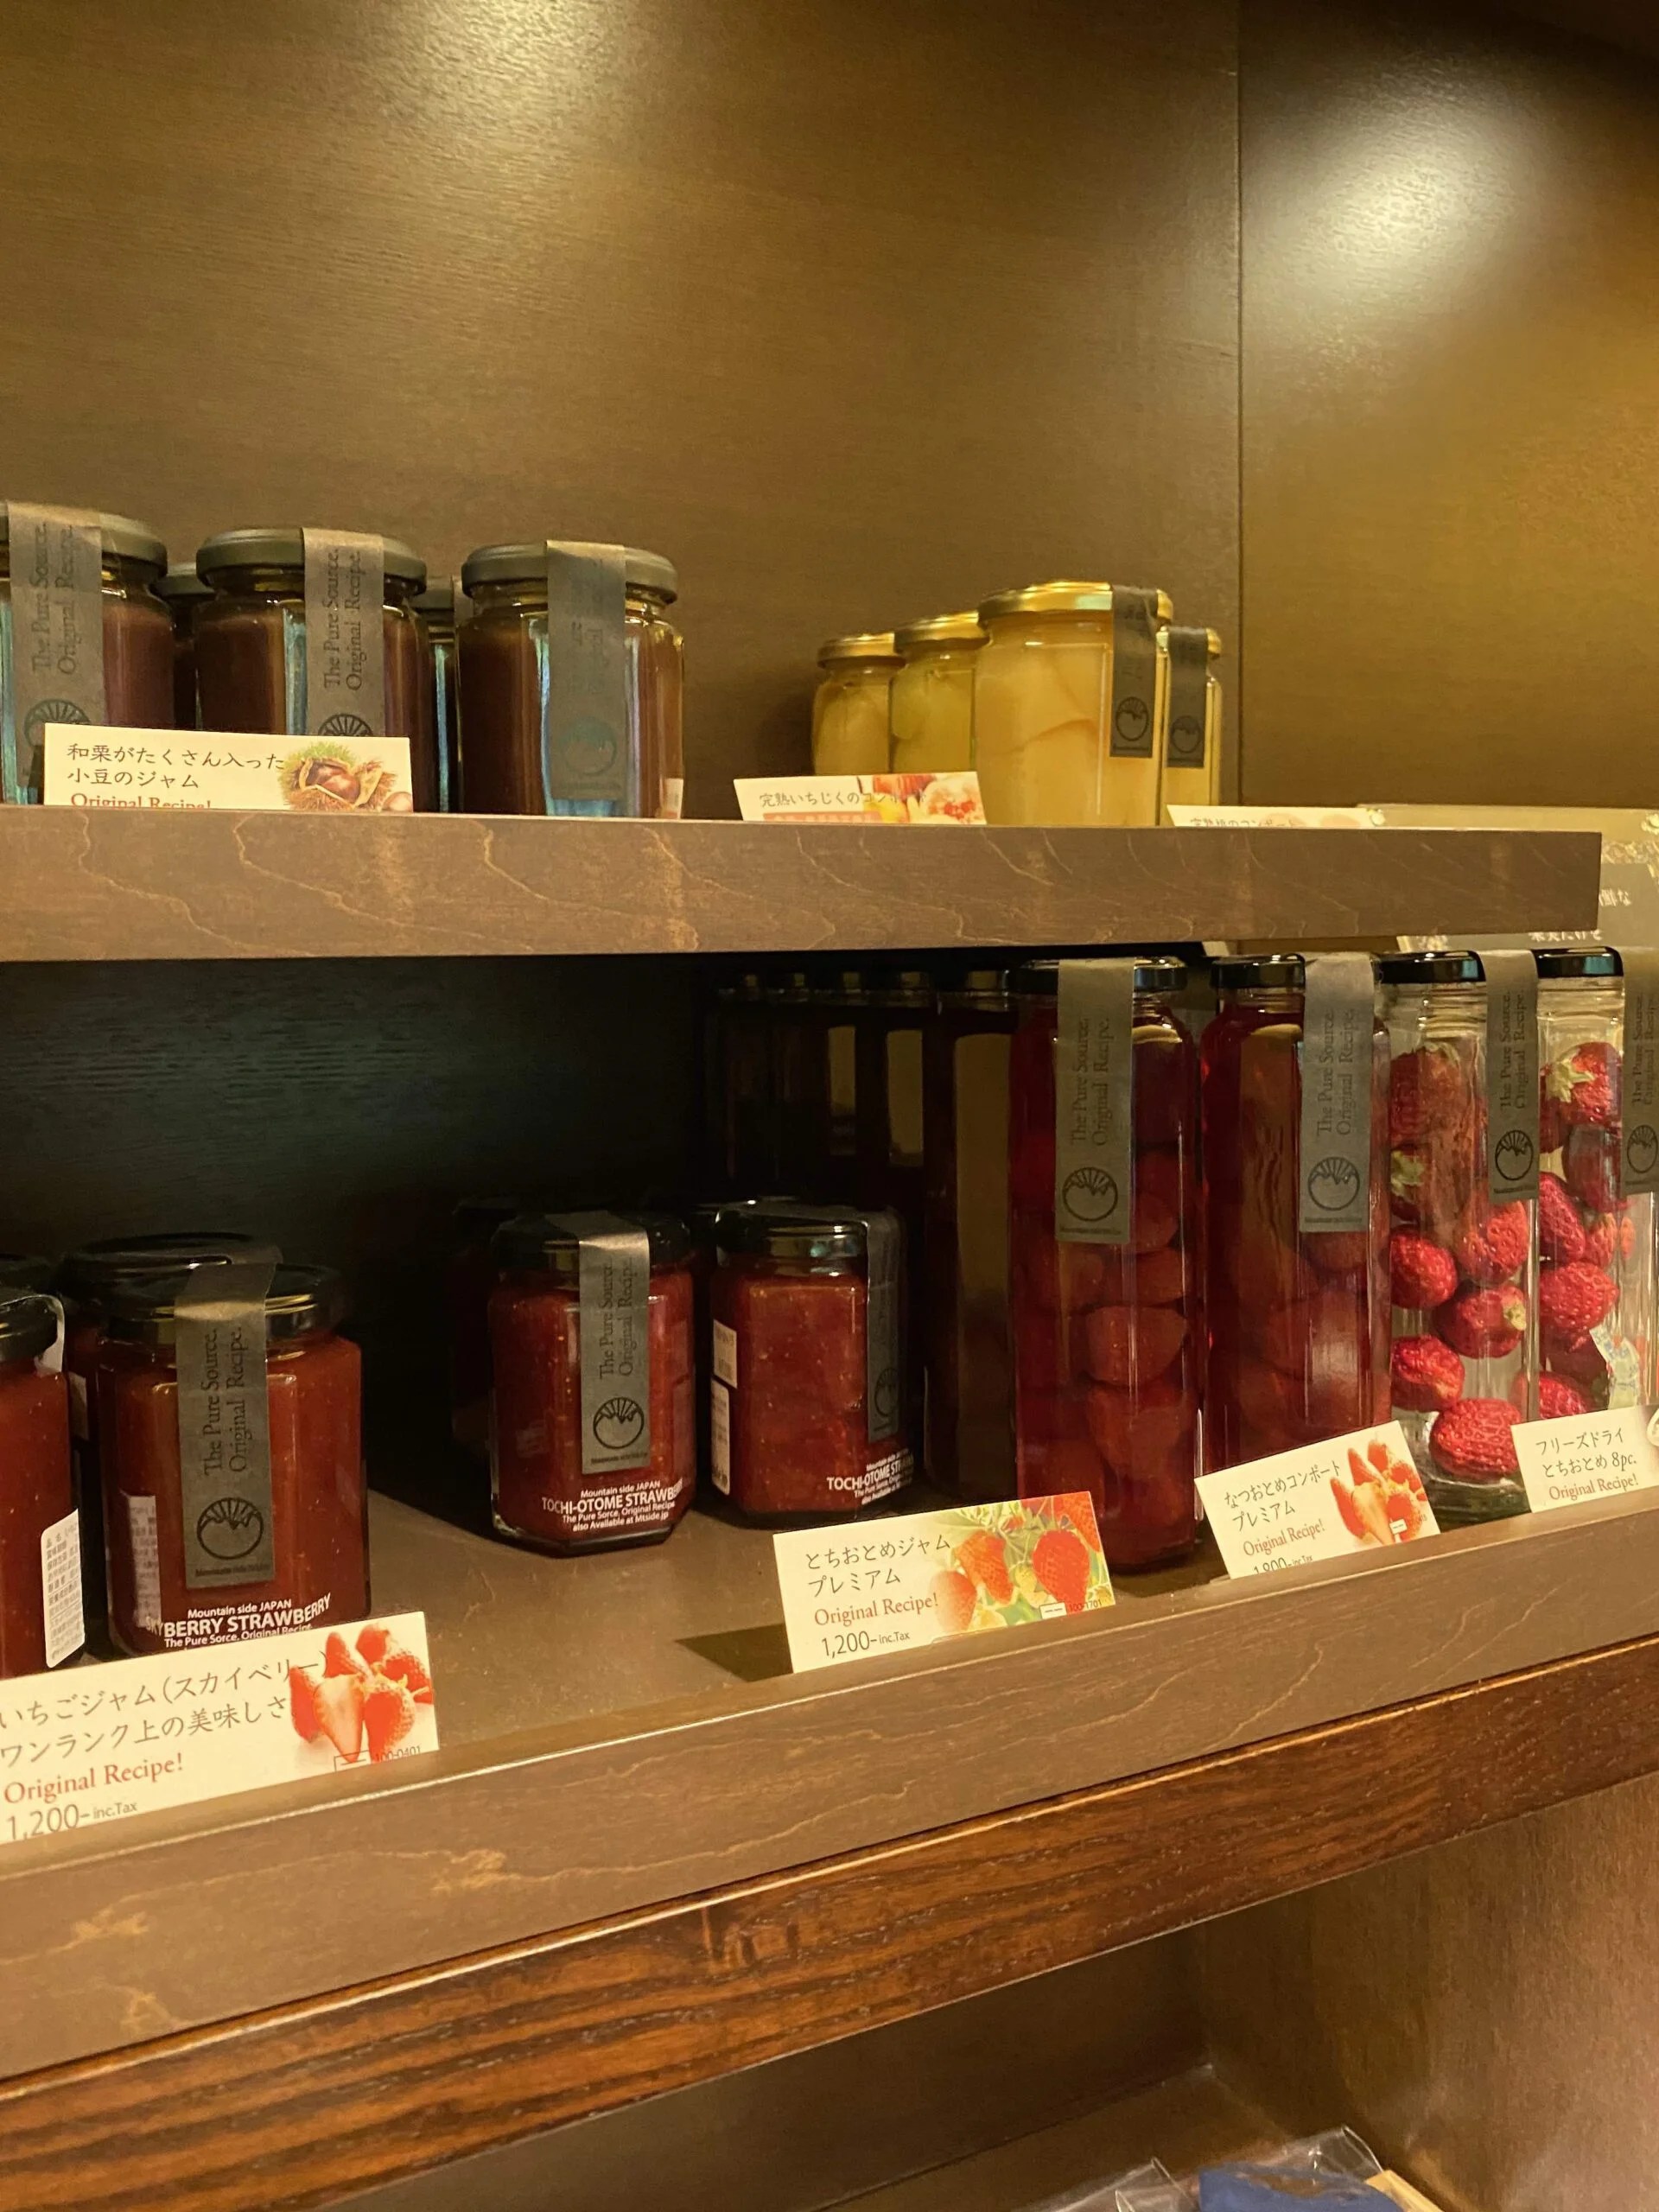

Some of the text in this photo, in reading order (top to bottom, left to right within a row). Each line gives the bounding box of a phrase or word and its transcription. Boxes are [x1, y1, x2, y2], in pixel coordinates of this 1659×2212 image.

[324, 614, 340, 652] Pure
[344, 620, 367, 691] Original
[324, 657, 340, 689] The
[67, 743, 285, 770] 和栗がたくさん入った
[67, 767, 199, 788] 小豆のジャム
[1317, 1106, 1332, 1136] The
[600, 1313, 613, 1347] Pure
[617, 1316, 638, 1376] Original
[600, 1351, 614, 1379] The
[202, 1395, 221, 1436] Pure
[226, 1400, 253, 1472] Original
[1535, 1427, 1624, 1456] フリーズドライ
[203, 1440, 222, 1476] The
[581, 1479, 661, 1499] Mountain side JAPAN
[826, 1465, 890, 1491] TOCHI-OTOME
[1224, 1459, 1340, 1509] なつおとめコンポート
[1548, 1472, 1639, 1501] Original Recipe!
[542, 1478, 683, 1515] TOCHI-OTOME STRAWB
[563, 1515, 576, 1523] The
[578, 1512, 596, 1522] Pure
[621, 1503, 652, 1516] Original
[572, 1522, 589, 1532] also
[590, 1515, 625, 1529] Available
[1232, 1500, 1296, 1532] プレミアム
[805, 1535, 950, 1570] とちおとめジャム
[1243, 1518, 1325, 1556] Original Recipe!
[808, 1568, 901, 1598] プレミアム
[188, 1599, 292, 1619] Mountain side JAPAN
[226, 1592, 331, 1633] STRAWBERRY
[814, 1592, 939, 1626] Original Recipe!
[164, 1638, 183, 1649] The
[185, 1635, 207, 1646] Pure
[209, 1633, 240, 1645] Sorce.
[241, 1626, 280, 1640] Original
[1, 1695, 287, 1768] ワンランク上の美味しさ
[4, 1752, 183, 1804] Original Recipe!
